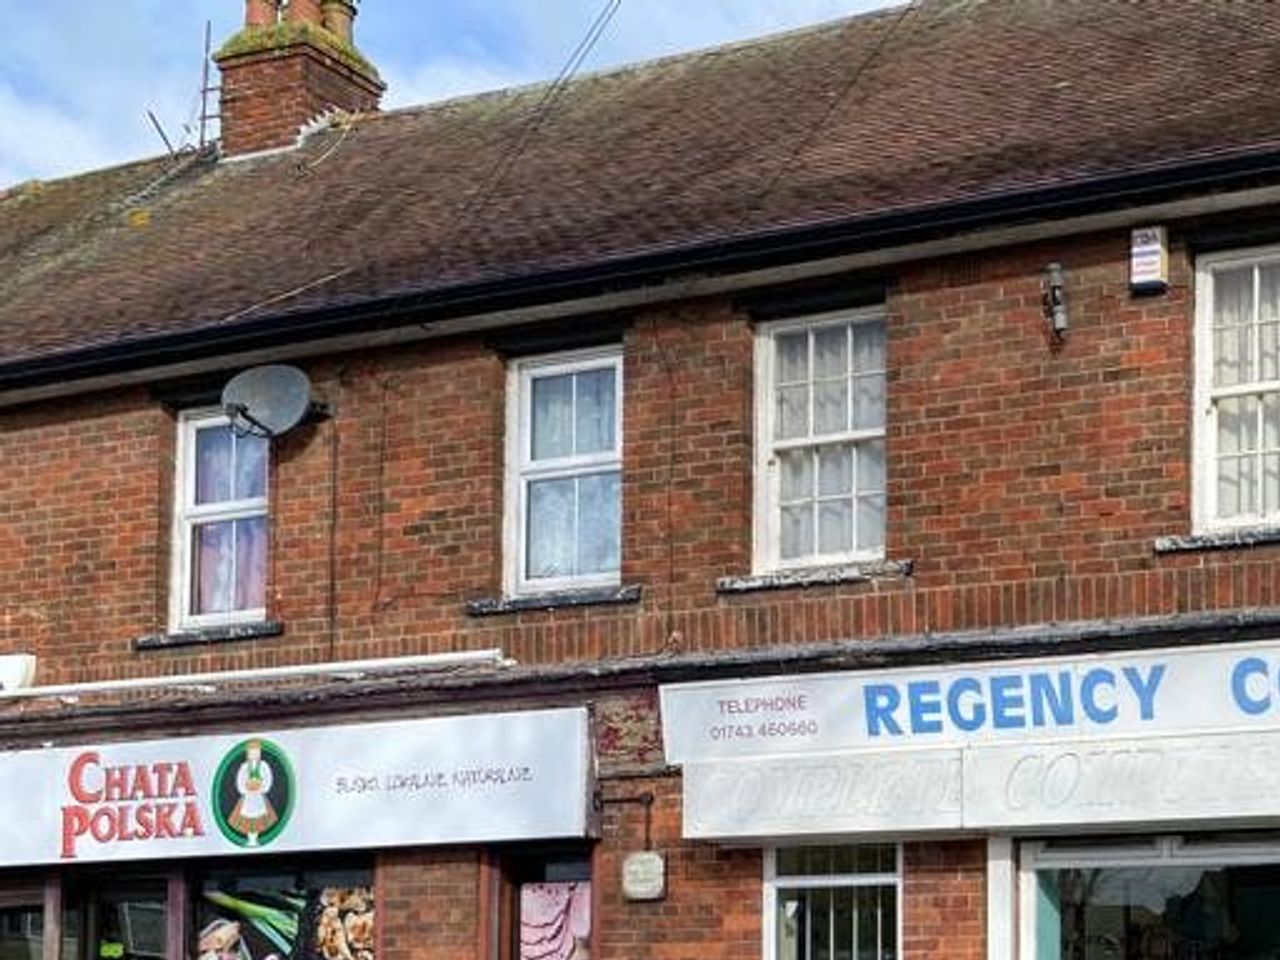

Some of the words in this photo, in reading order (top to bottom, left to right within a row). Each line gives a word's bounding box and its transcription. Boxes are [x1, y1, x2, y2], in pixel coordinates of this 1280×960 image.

[718, 695, 808, 714] TELEPHONE
[863, 664, 1167, 738] REGENCY
[710, 725, 753, 740] 01743
[68, 751, 198, 804] CHATA
[60, 803, 205, 858] POLSKA
